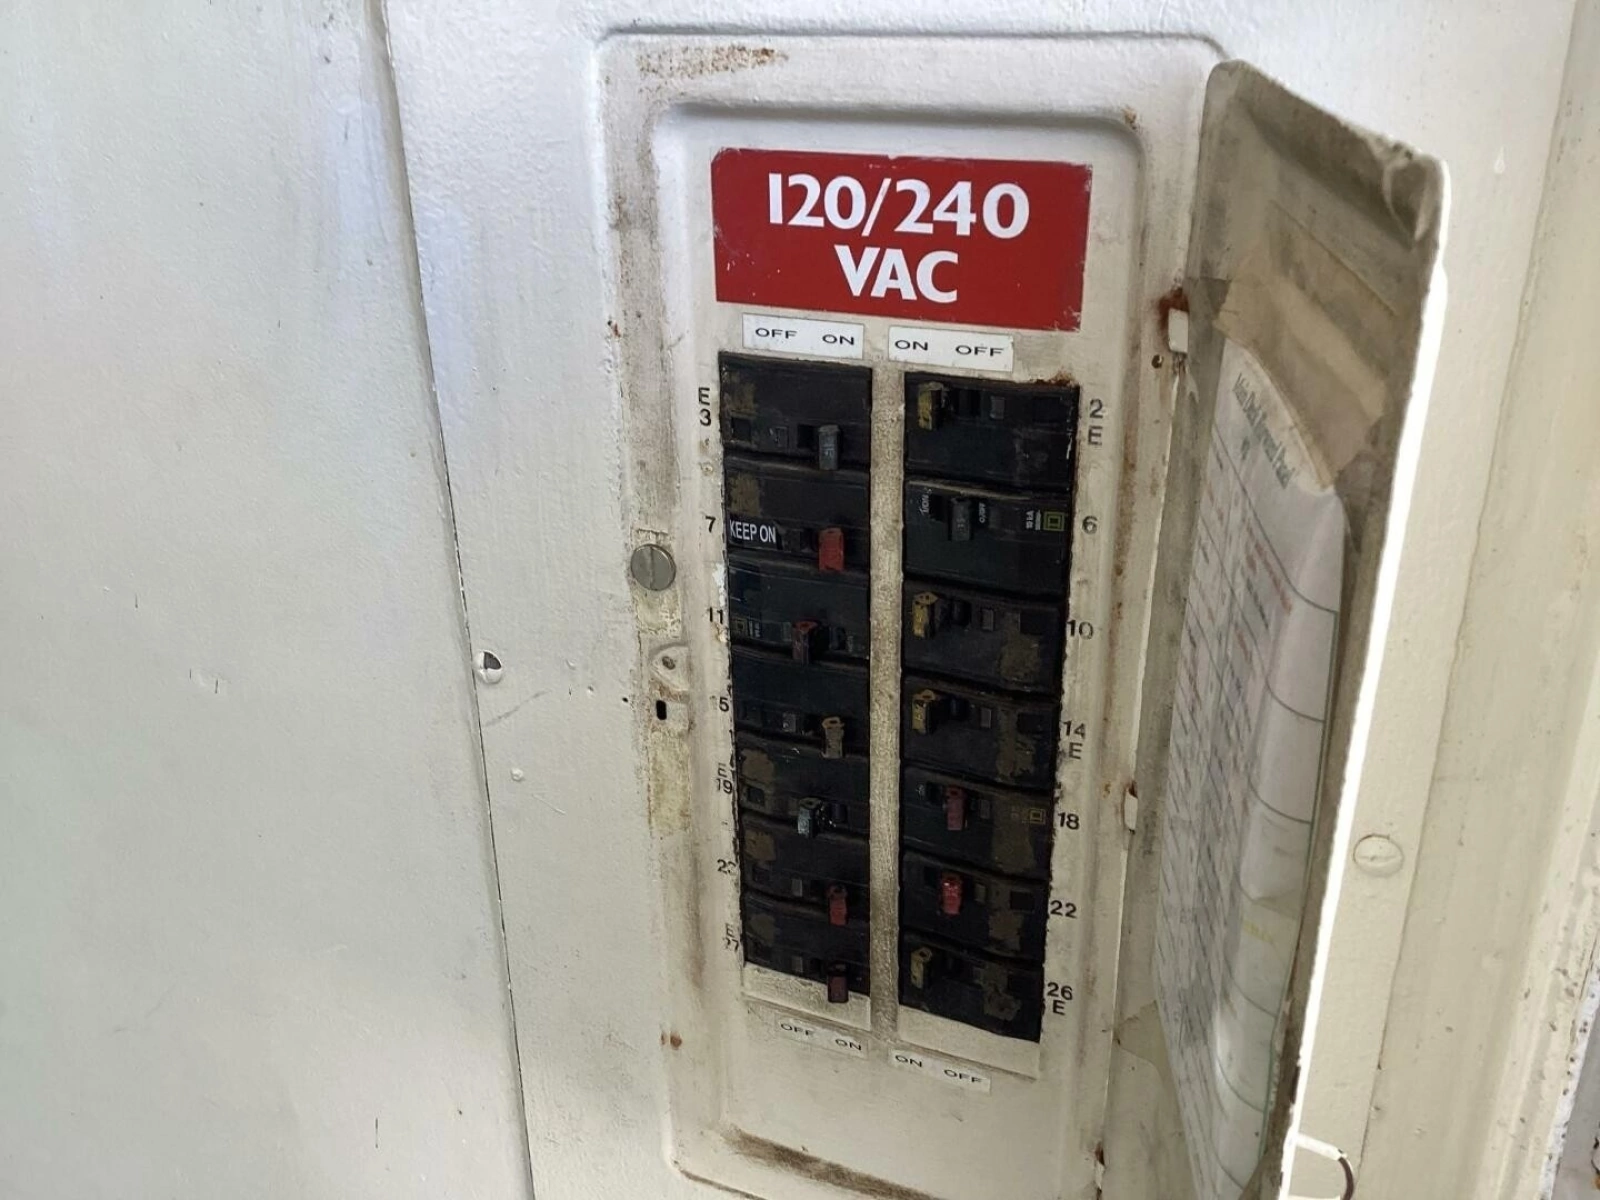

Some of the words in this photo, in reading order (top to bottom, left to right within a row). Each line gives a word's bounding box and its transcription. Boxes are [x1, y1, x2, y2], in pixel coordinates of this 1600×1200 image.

[768, 172, 1030, 239] 120/240
[834, 244, 958, 303] VAC
[754, 326, 797, 340] OFF
[821, 333, 855, 346] ON
[894, 339, 929, 351] ON
[955, 345, 1004, 358] OFF
[698, 387, 711, 406] E
[699, 408, 712, 426] 3
[1089, 398, 1104, 419] 2
[1087, 425, 1103, 446] E
[705, 515, 716, 533] 7
[729, 519, 758, 541] KEEP
[759, 525, 777, 544] ON
[1081, 515, 1098, 534] 6
[707, 606, 724, 625] 11
[1066, 619, 1094, 640] 10
[1062, 720, 1087, 740] 14
[1068, 742, 1083, 760] E
[717, 762, 728, 778] E
[715, 778, 733, 795] 19
[1057, 811, 1081, 830] 18
[1050, 900, 1078, 919] 22
[1046, 982, 1074, 1001] 26
[1052, 1000, 1066, 1016] E
[780, 1022, 815, 1037] OFF
[835, 1038, 862, 1052] ON
[895, 1054, 923, 1068] ON
[944, 1069, 983, 1084] OFF
